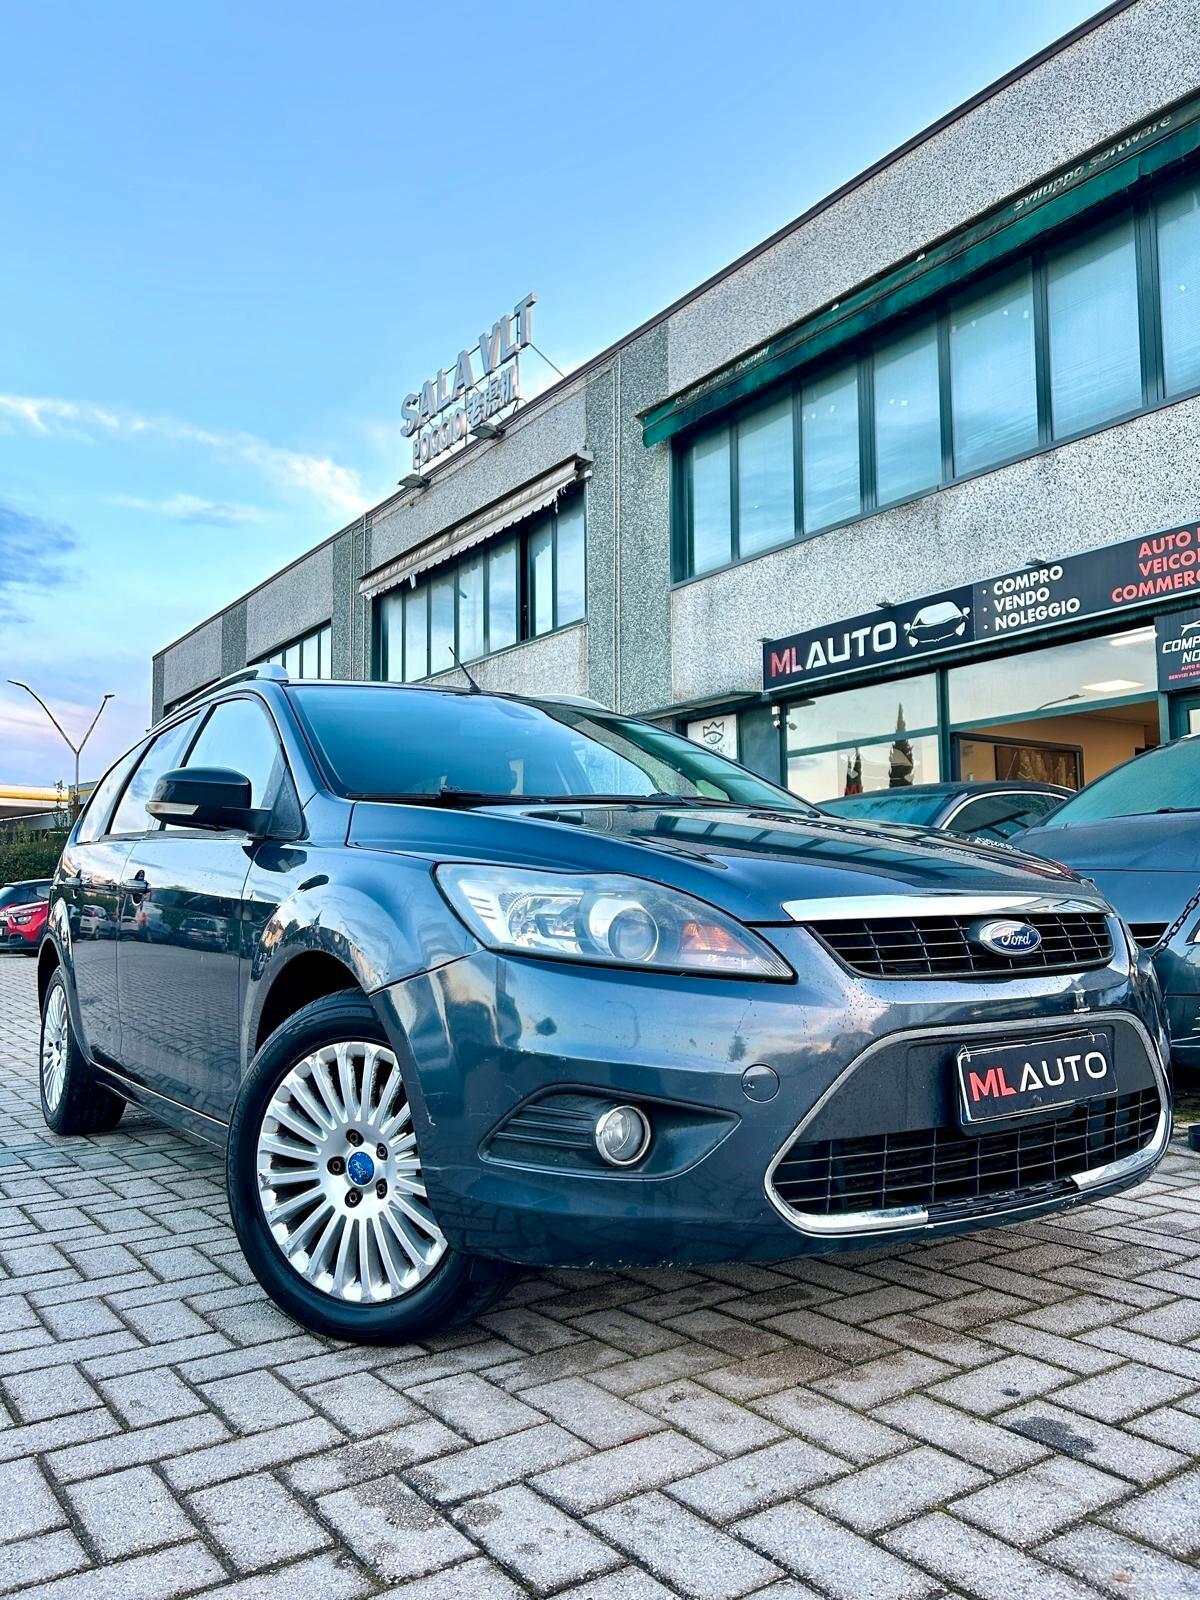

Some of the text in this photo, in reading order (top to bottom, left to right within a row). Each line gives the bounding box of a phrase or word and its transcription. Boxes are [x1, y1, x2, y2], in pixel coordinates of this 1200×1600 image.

[1013, 165, 1085, 211] Sviluppo
[400, 291, 537, 438] SALA VLT
[413, 407, 467, 470] POGGIO
[1138, 530, 1192, 559] AUTO
[993, 565, 1063, 595] COMPRO
[993, 587, 1050, 612] VENDO
[995, 597, 1080, 632] NOLEGGIO
[1001, 928, 1035, 946] Ford
